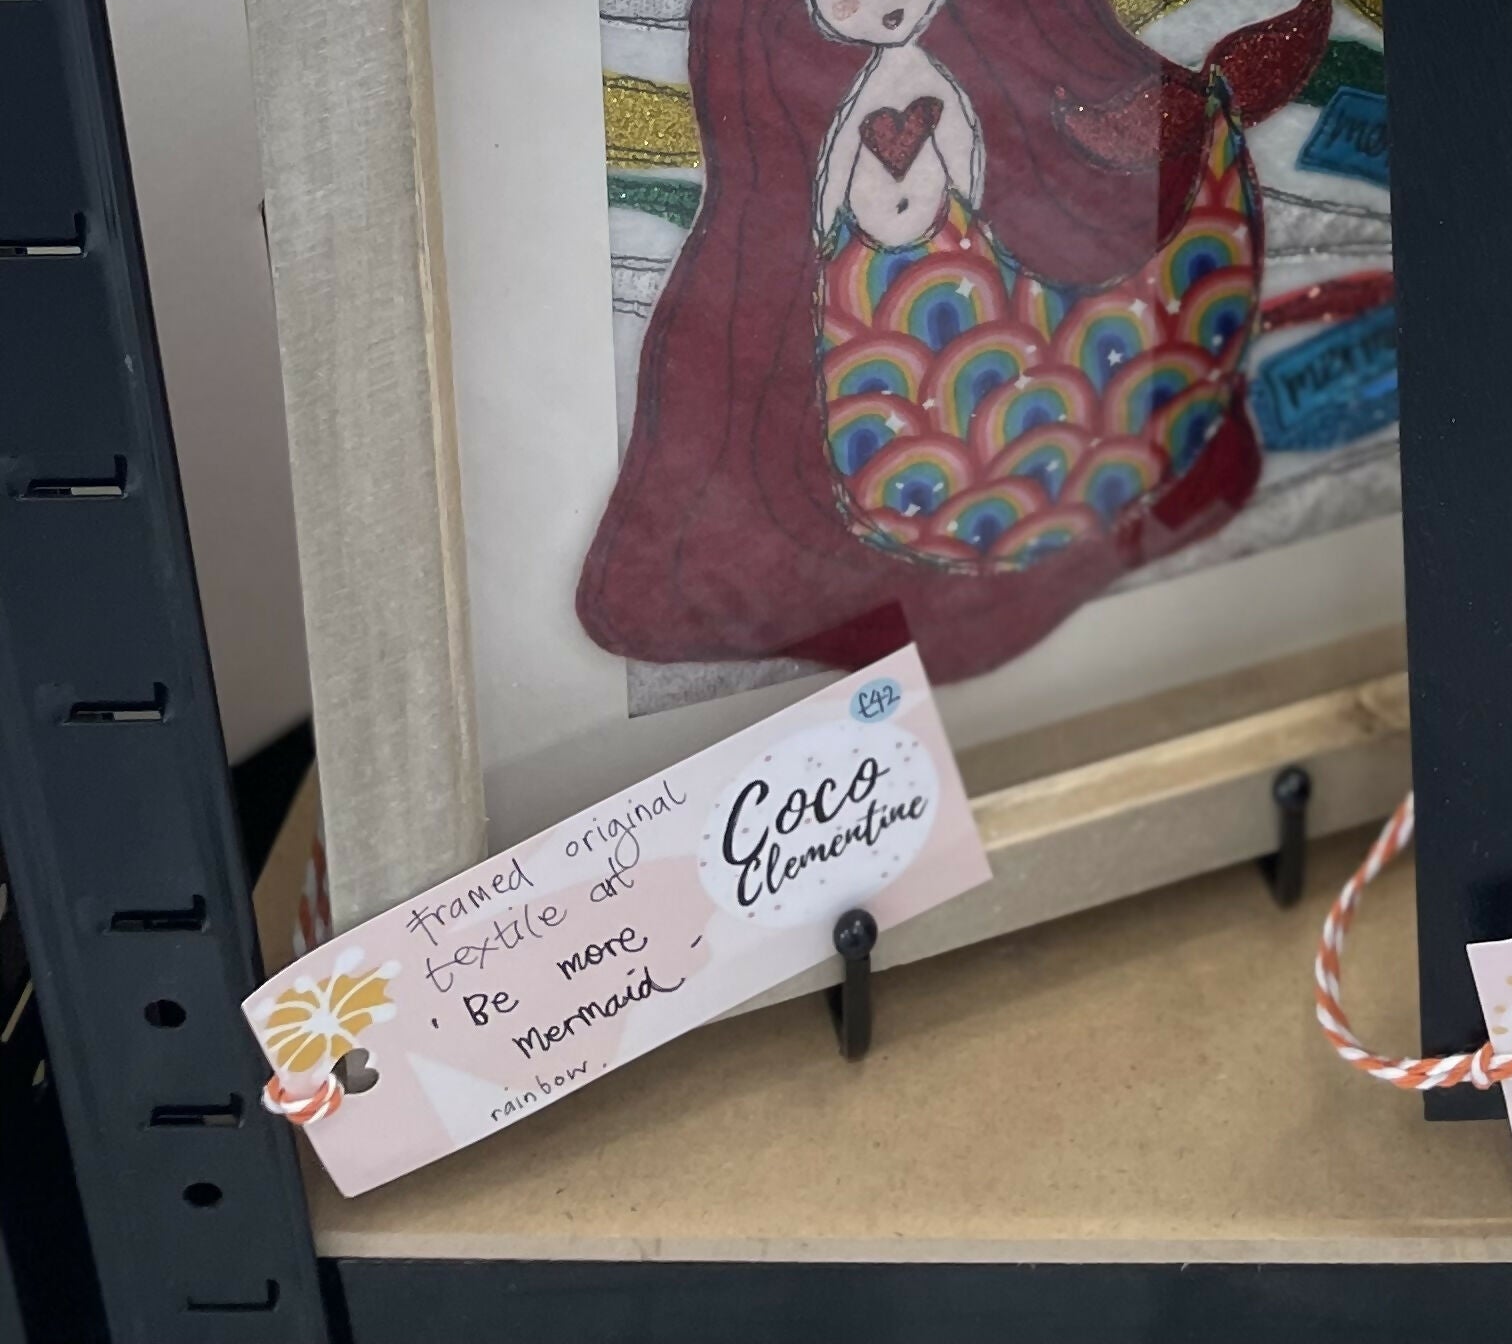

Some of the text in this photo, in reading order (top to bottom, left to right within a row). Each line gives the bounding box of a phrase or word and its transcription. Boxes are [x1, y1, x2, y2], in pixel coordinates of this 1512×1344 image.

[857, 684, 901, 719] £42
[406, 780, 687, 946] Framed original
[722, 757, 891, 866] Coco
[737, 795, 929, 908] Clementine
[424, 856, 635, 994] textile art
[556, 926, 648, 981] more
